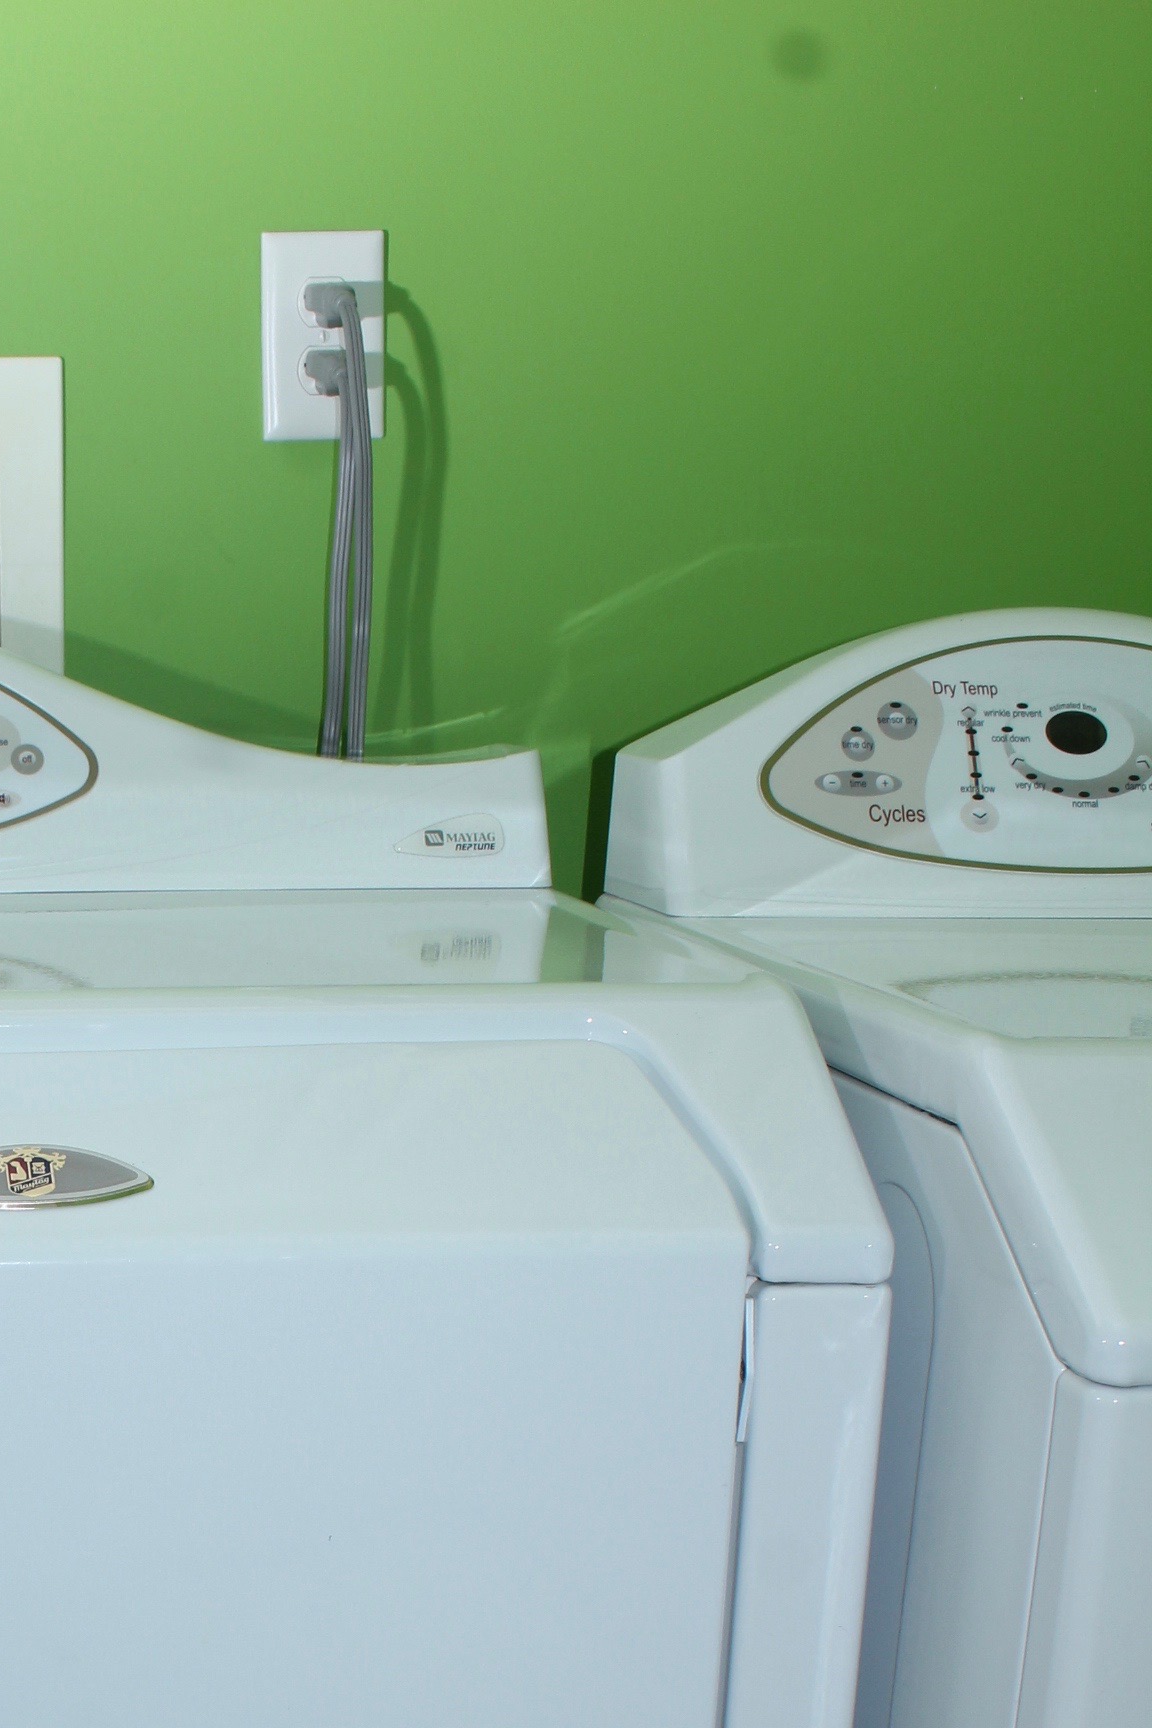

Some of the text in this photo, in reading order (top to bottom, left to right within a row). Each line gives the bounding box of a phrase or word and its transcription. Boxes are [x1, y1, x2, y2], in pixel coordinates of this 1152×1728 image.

[932, 681, 998, 698] Dry Temp
[1049, 702, 1097, 713] estimated time
[1012, 710, 1042, 718] prevent
[877, 716, 918, 726] sensor dry
[991, 735, 1031, 743] cool down
[842, 741, 874, 752] time dry
[21, 755, 33, 763] off
[850, 780, 867, 788] time
[981, 785, 996, 793] low
[1015, 781, 1046, 791] very dry
[1125, 782, 1147, 792] damp
[1072, 799, 1099, 808] normal
[869, 803, 926, 827] Cycles
[446, 832, 496, 842] MAYTAG
[455, 842, 495, 851] NEPTUNE
[13, 1176, 50, 1192] Maytag
